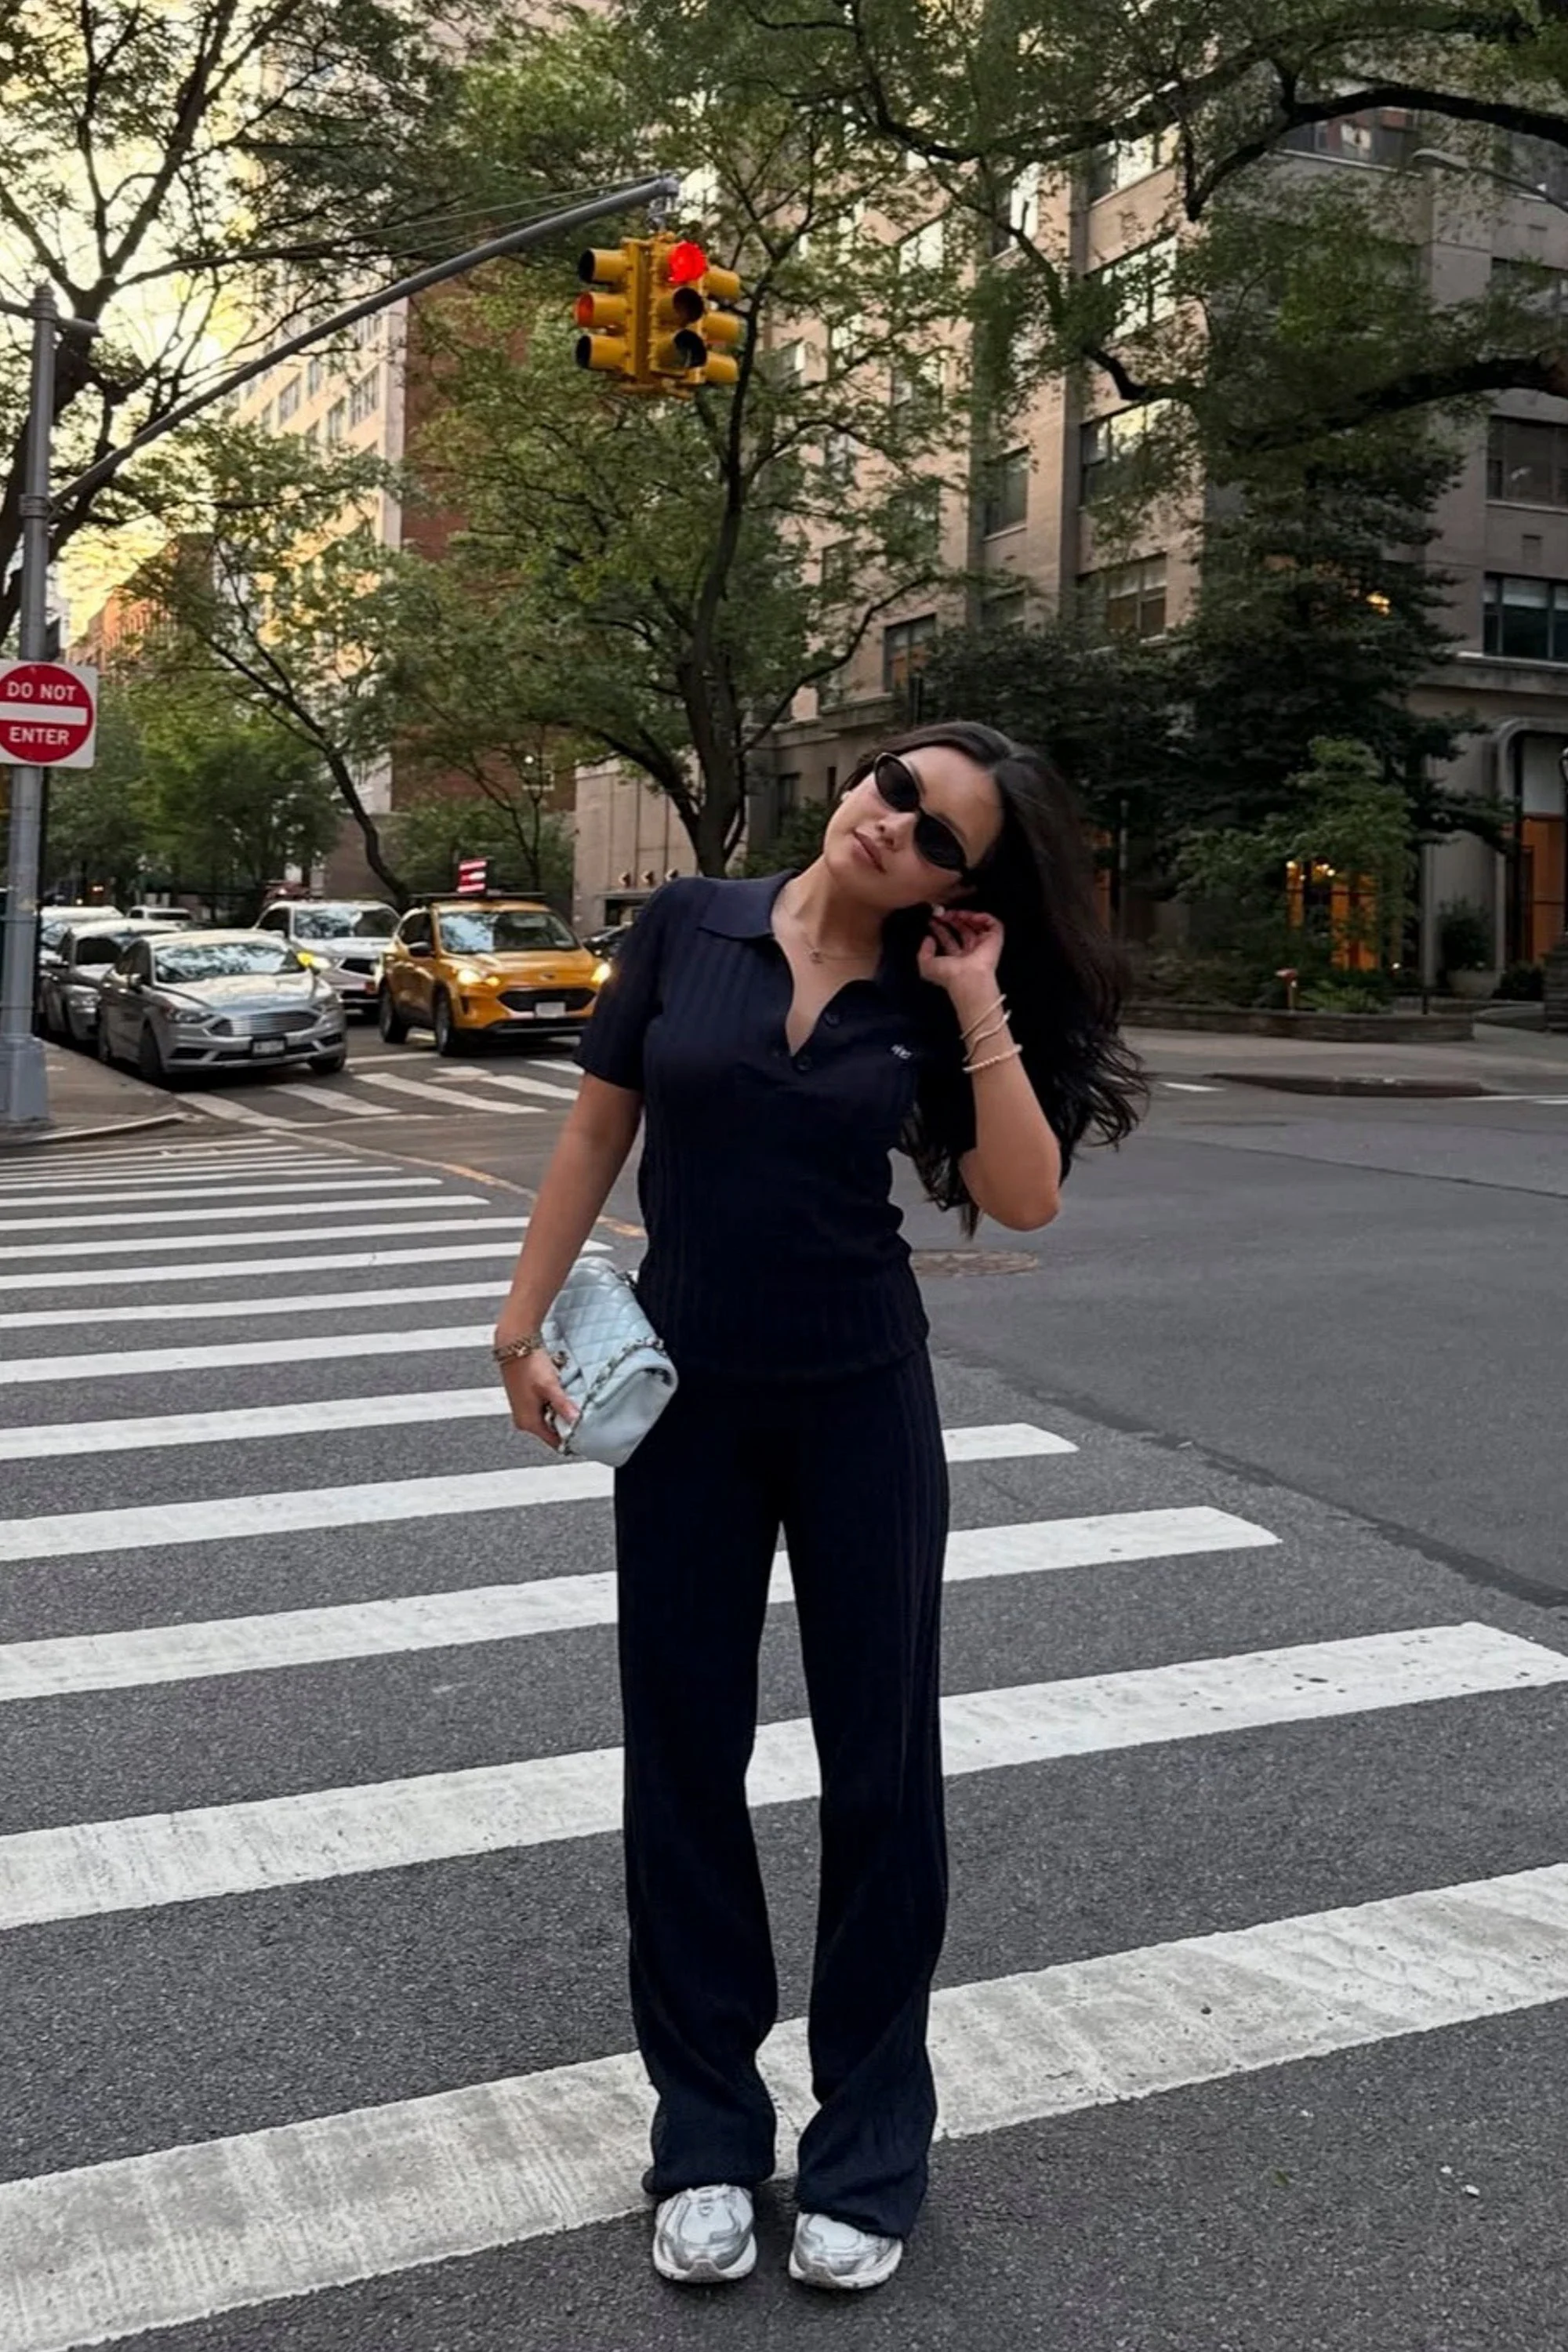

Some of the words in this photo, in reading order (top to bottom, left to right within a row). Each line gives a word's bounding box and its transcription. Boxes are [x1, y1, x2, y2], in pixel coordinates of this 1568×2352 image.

[6, 681, 34, 699] DO
[40, 684, 77, 701] NOT
[9, 726, 70, 745] ENTER
